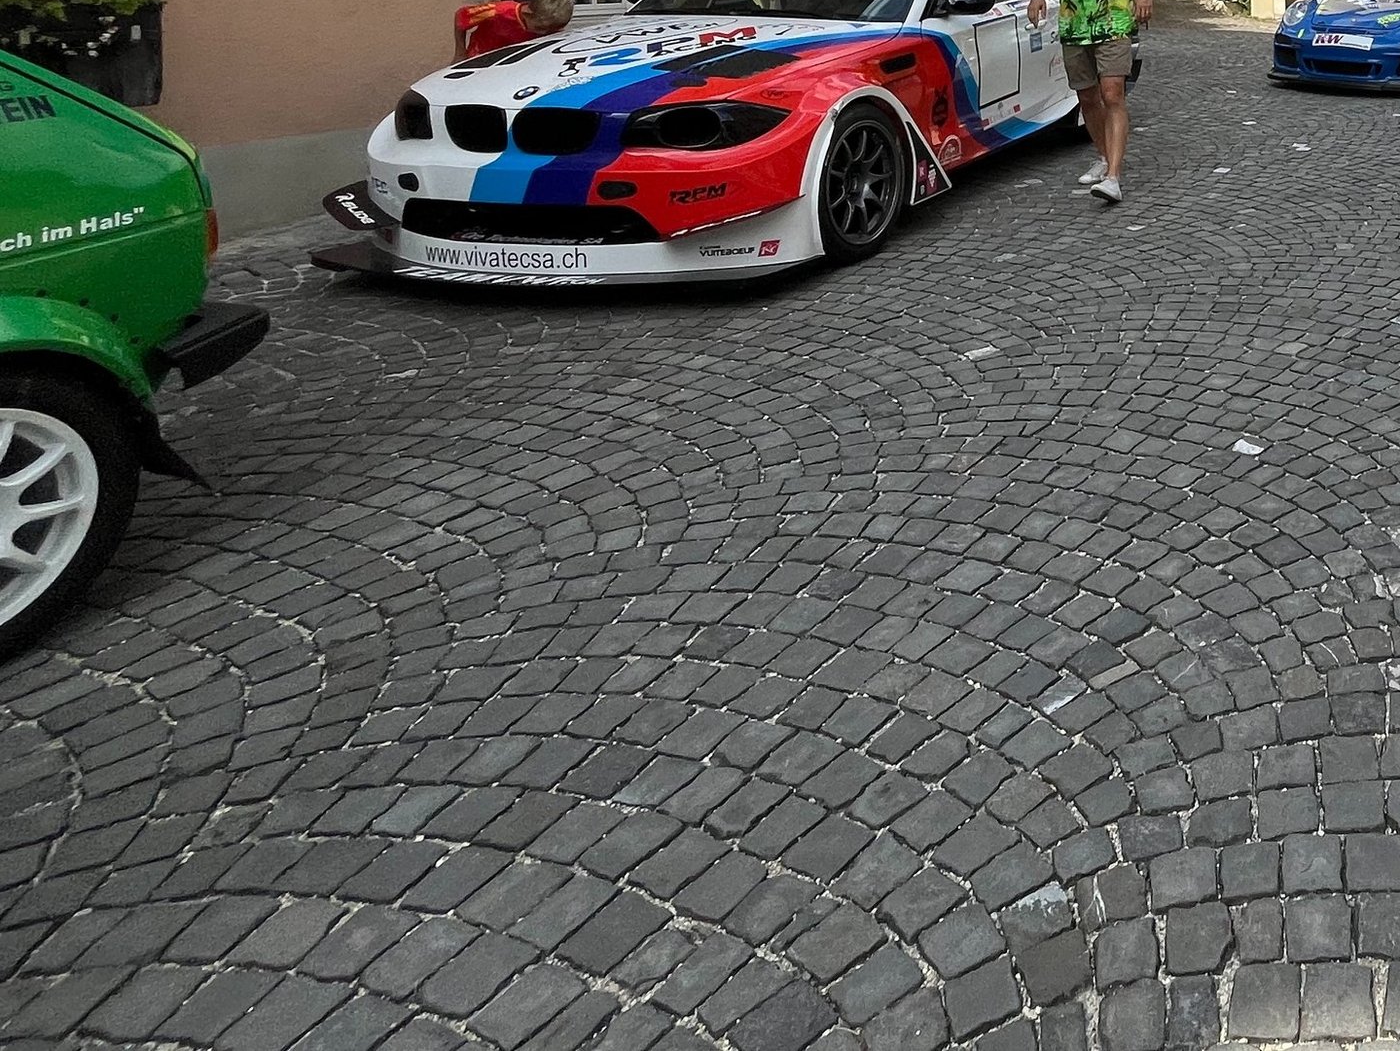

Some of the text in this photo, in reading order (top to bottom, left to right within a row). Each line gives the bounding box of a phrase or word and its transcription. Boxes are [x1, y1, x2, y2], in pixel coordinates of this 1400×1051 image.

[1314, 34, 1344, 45] KW
[669, 183, 727, 205] RPM
[41, 226, 73, 243] im
[80, 206, 145, 235] Hals"
[425, 245, 588, 269] www.vivatecsa.ch
